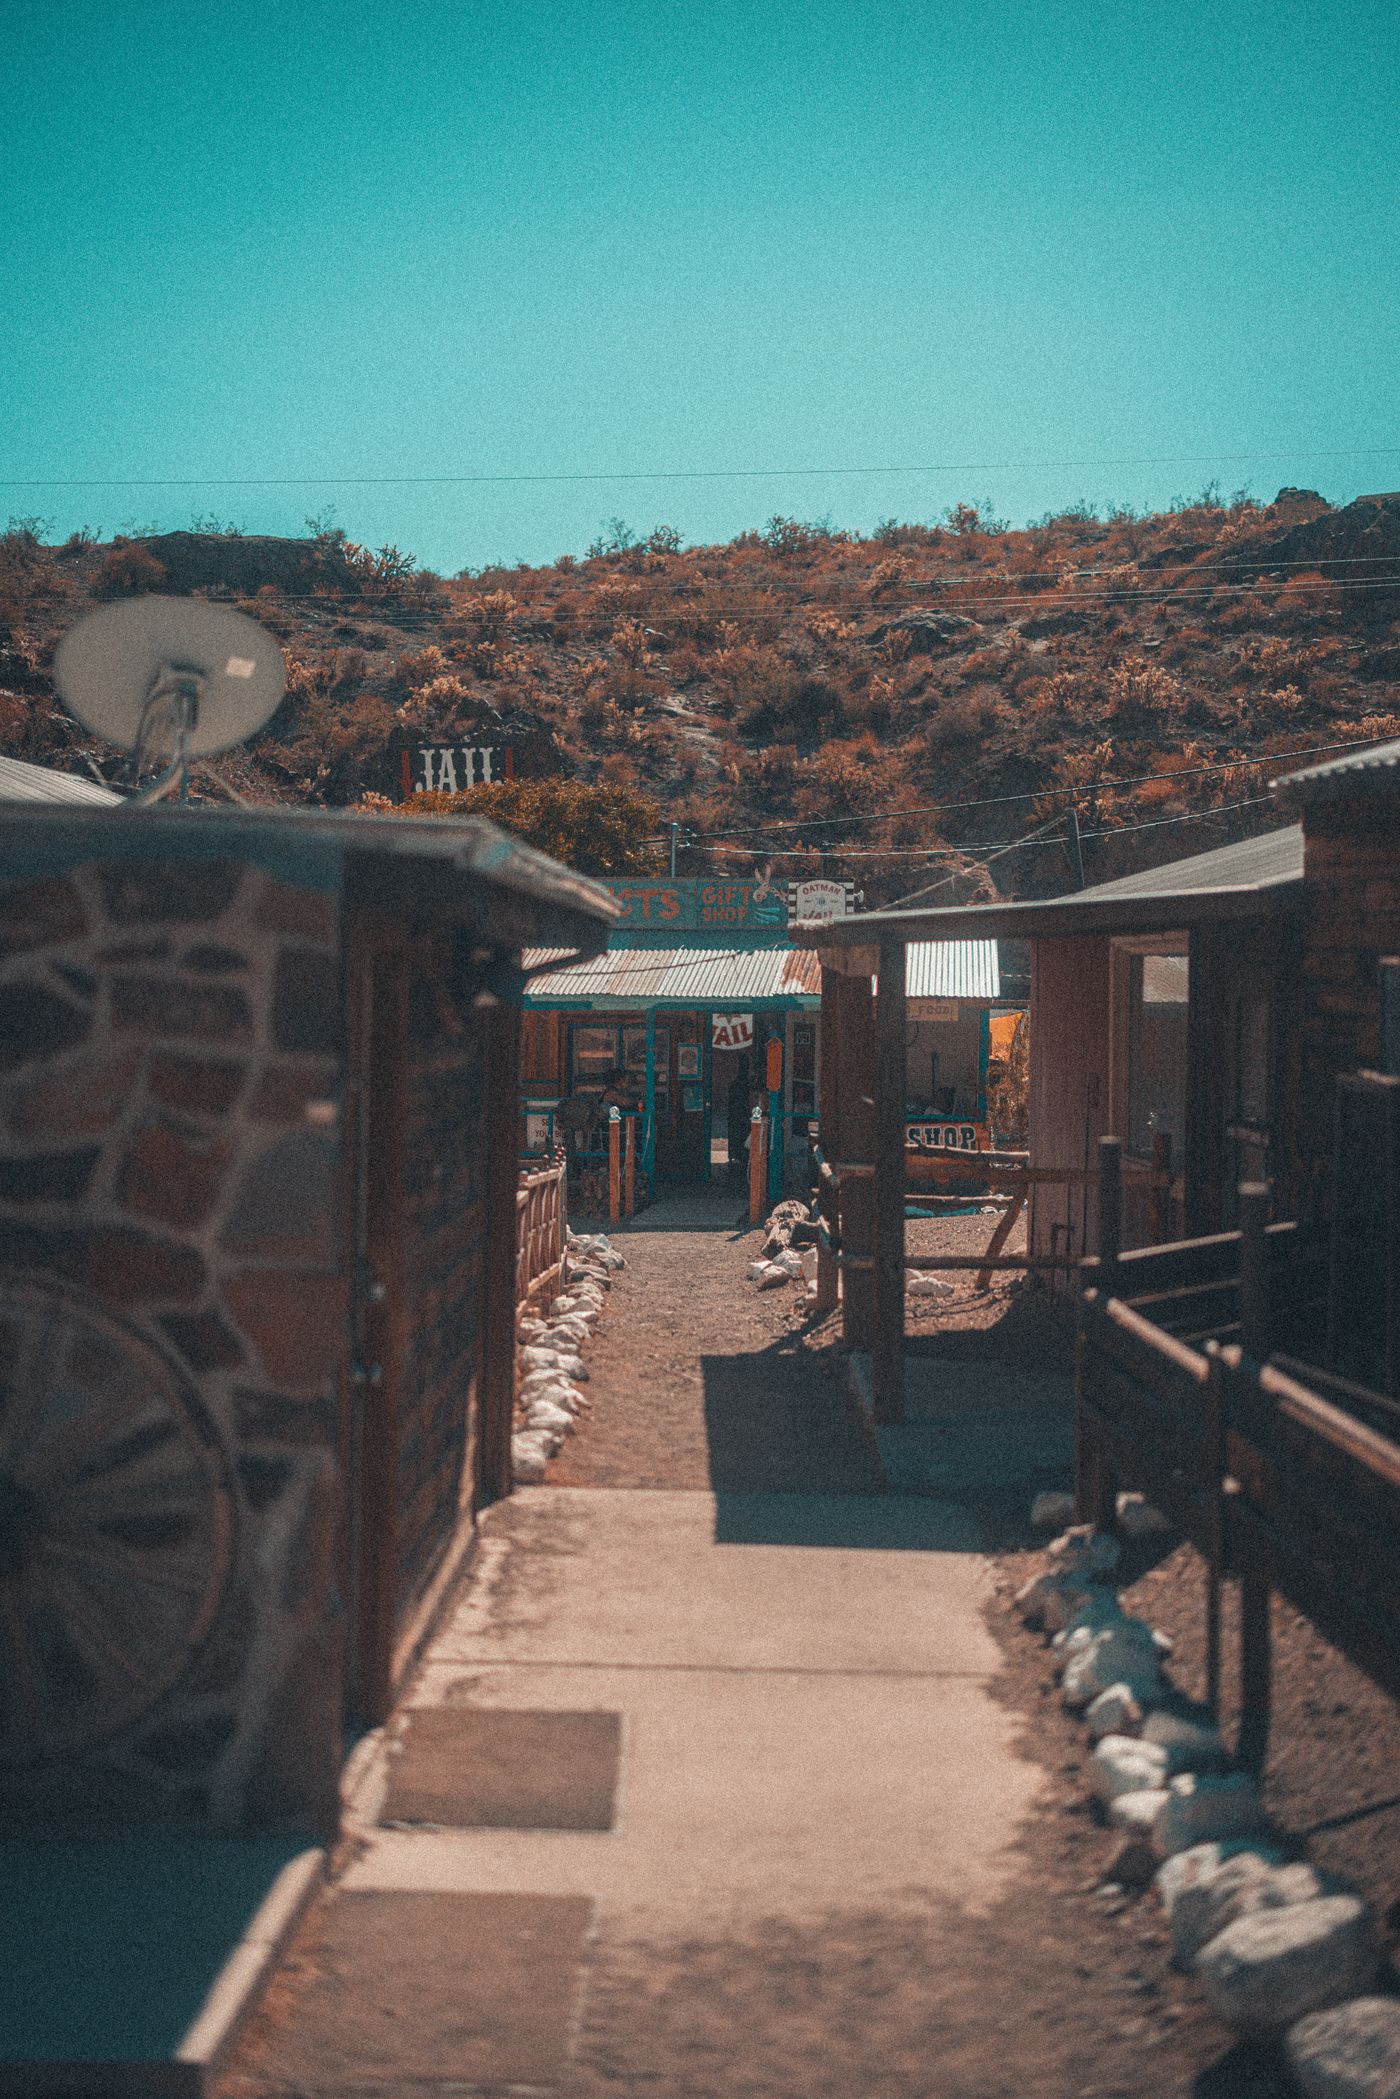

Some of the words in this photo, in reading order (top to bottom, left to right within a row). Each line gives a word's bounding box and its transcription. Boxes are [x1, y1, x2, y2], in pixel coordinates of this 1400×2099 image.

[415, 747, 502, 794] JAIL
[703, 886, 752, 905] GIFT
[803, 884, 841, 895] OATMAN
[703, 906, 748, 922] SHOP
[907, 1125, 976, 1151] SHOP
